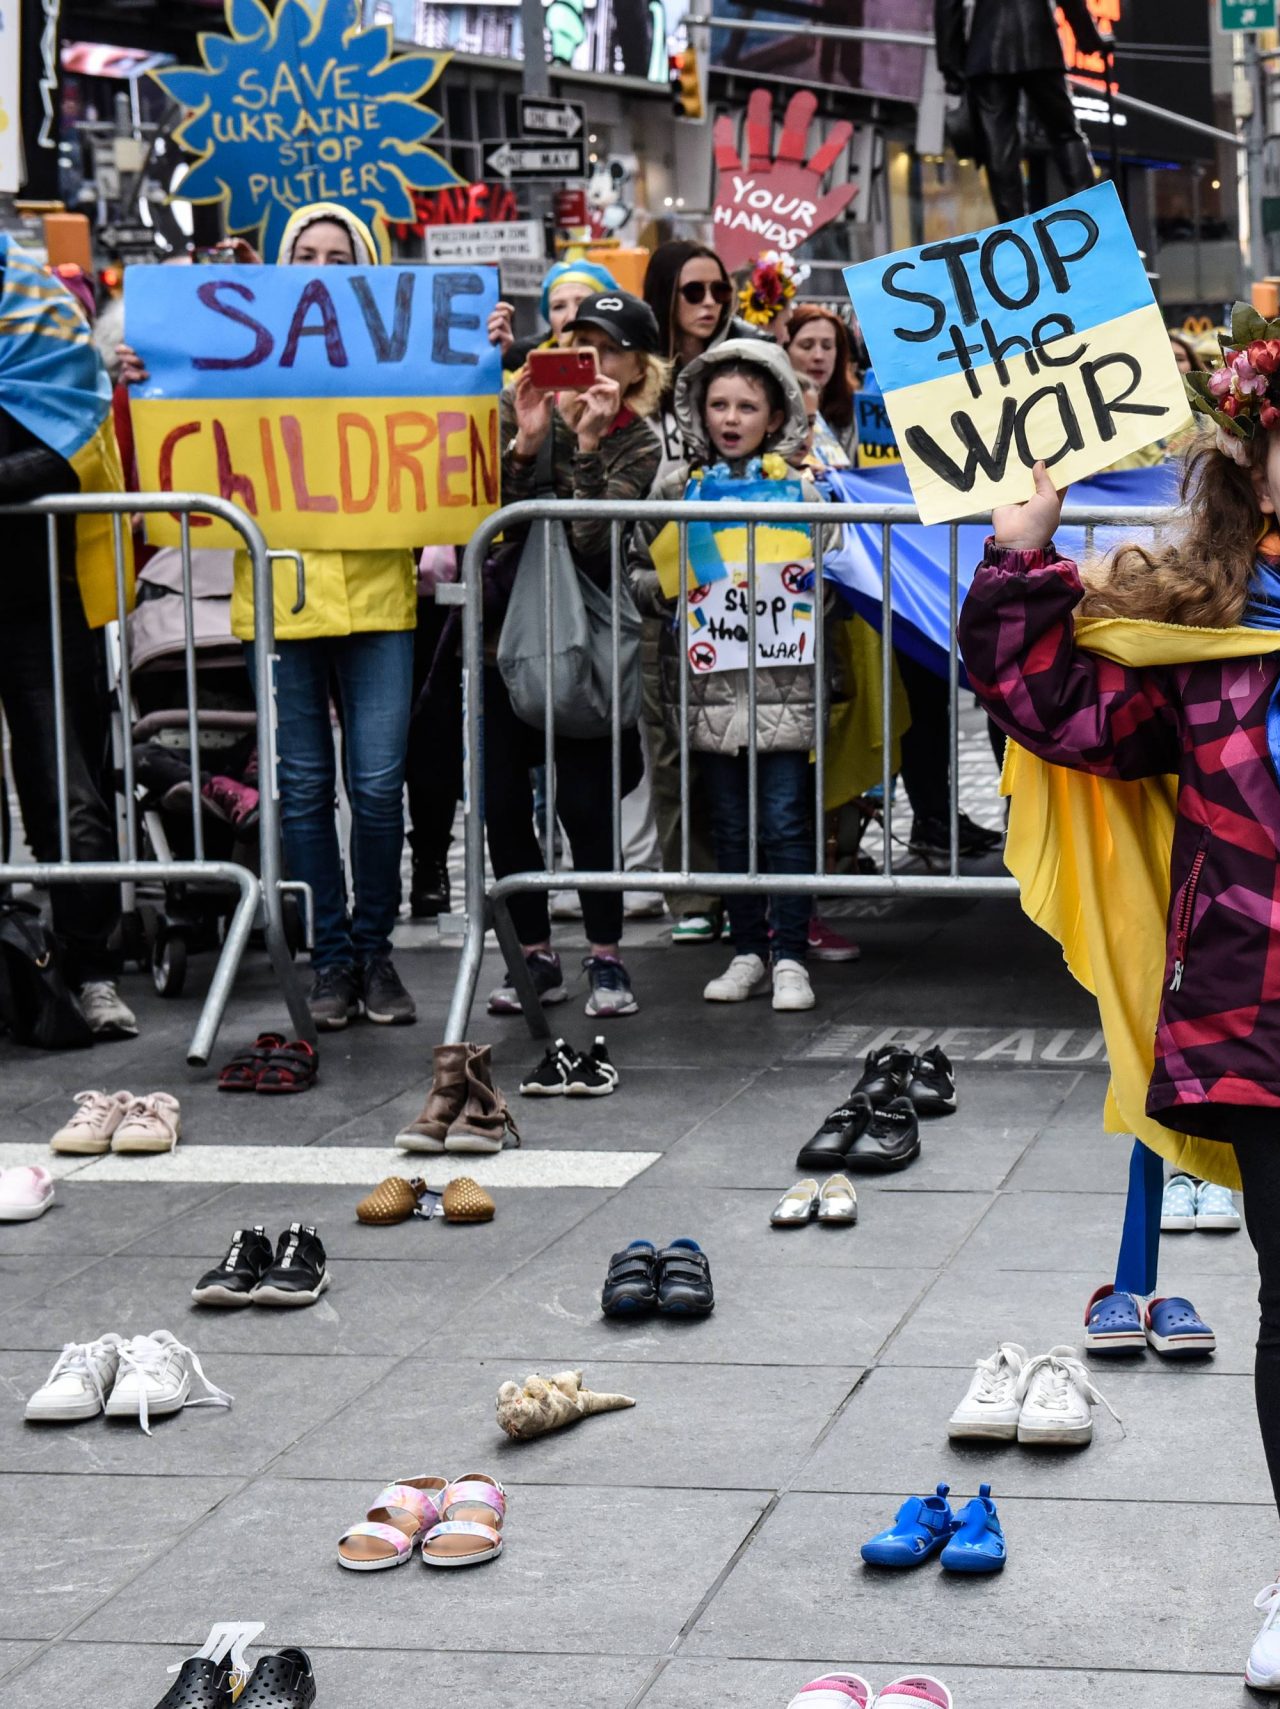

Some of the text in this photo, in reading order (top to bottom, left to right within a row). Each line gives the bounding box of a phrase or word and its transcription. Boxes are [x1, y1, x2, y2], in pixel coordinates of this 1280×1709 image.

[232, 58, 361, 110] SAVE
[211, 103, 381, 142] UKRAINE
[278, 136, 363, 166] STOP
[248, 163, 387, 205] PUTLER
[731, 176, 817, 228] YOUR
[714, 204, 808, 250] HANDS
[881, 209, 1099, 342] STOP
[191, 272, 487, 371] SAVE
[937, 313, 1088, 399] the
[707, 617, 750, 643] the
